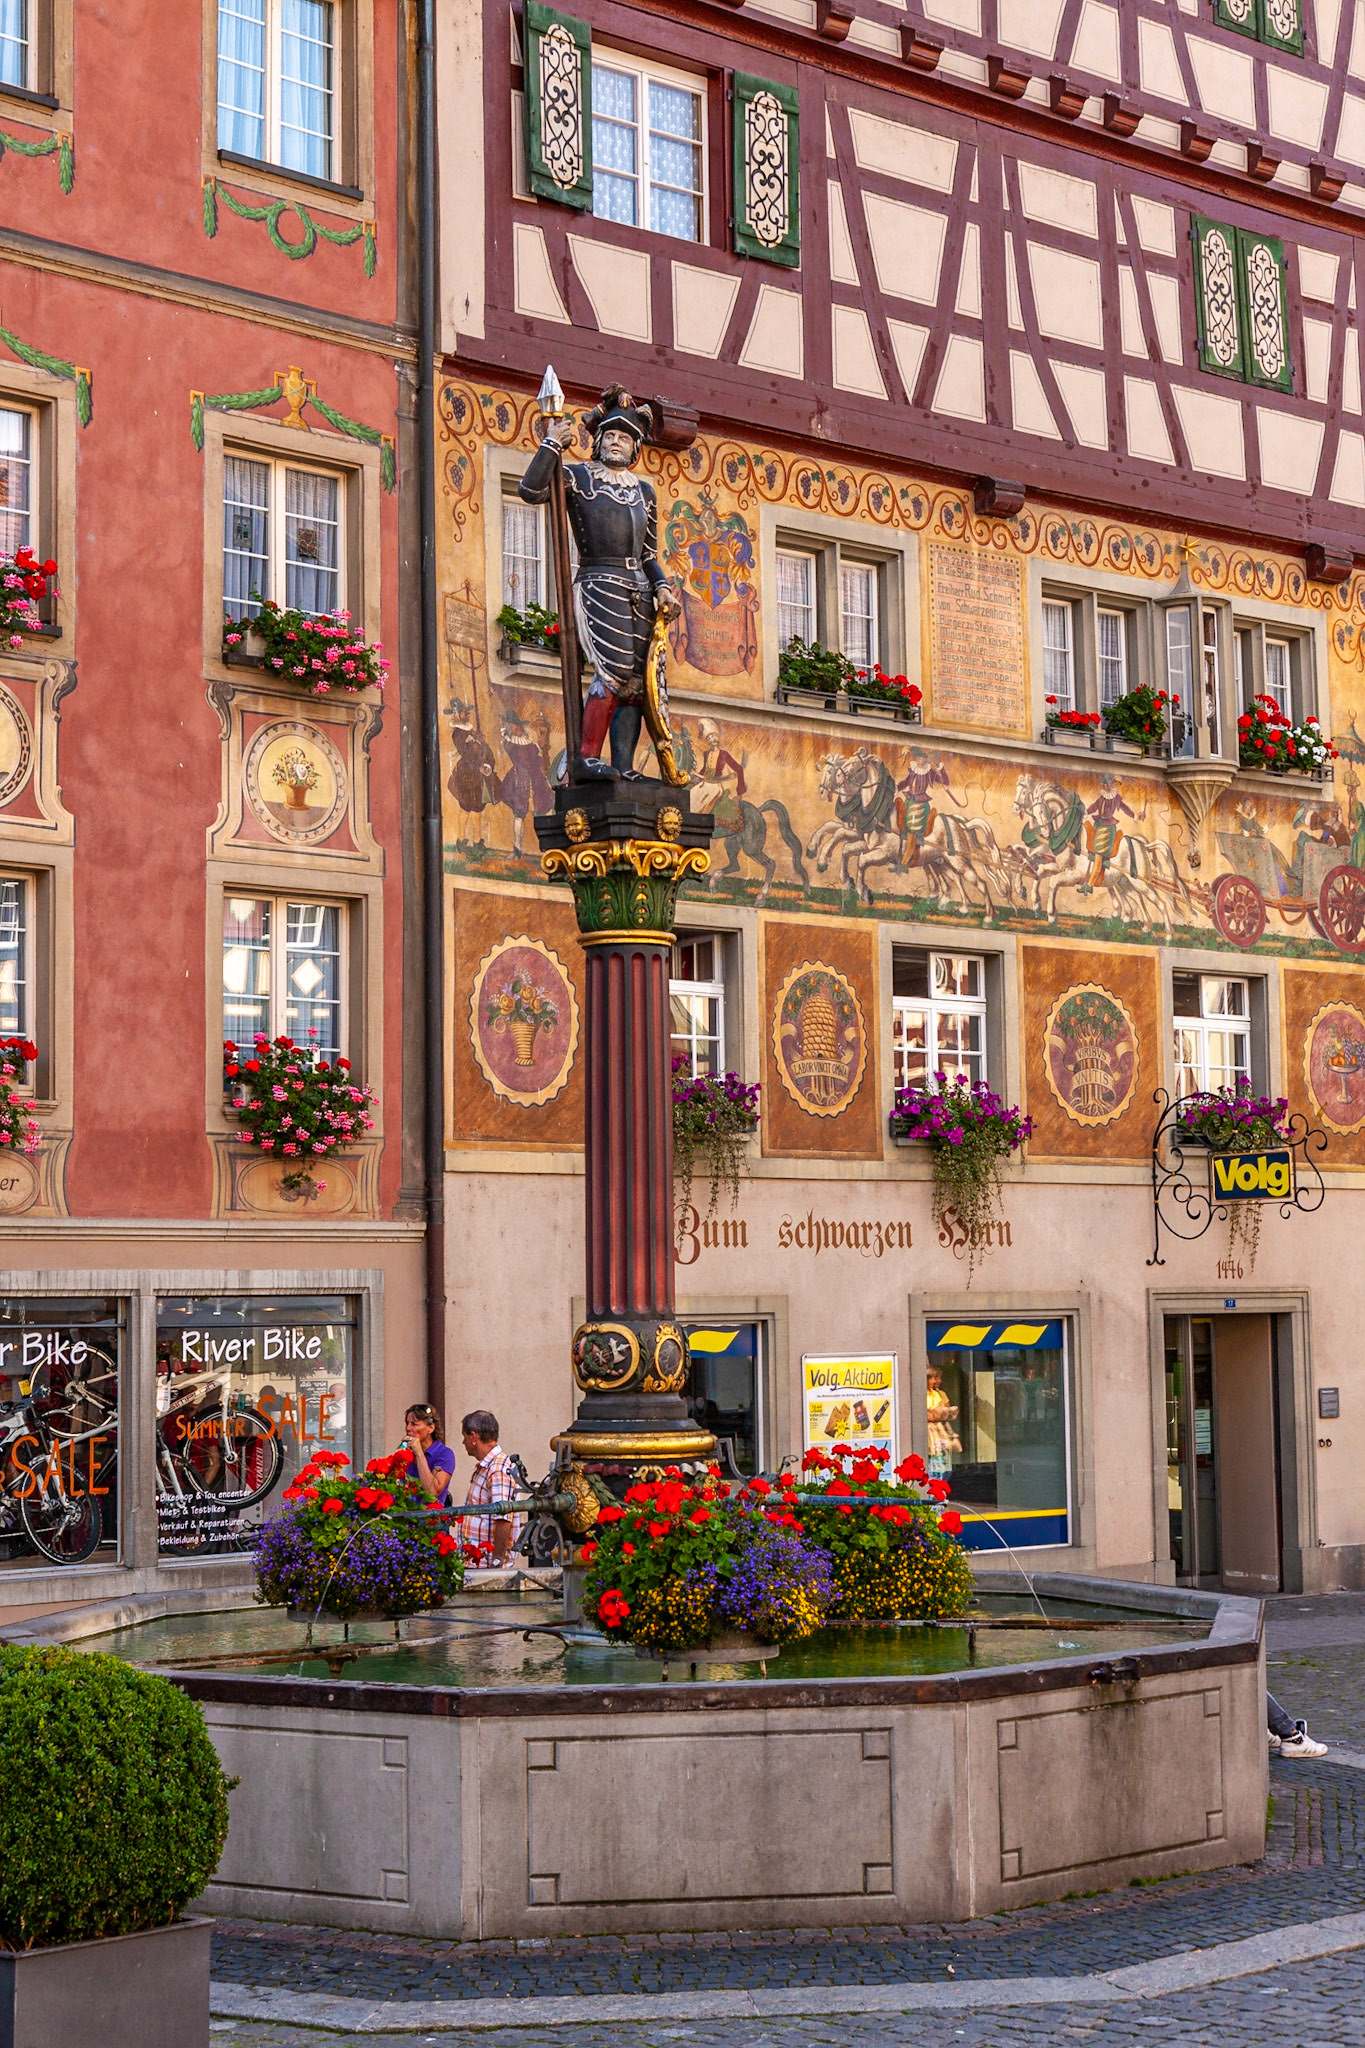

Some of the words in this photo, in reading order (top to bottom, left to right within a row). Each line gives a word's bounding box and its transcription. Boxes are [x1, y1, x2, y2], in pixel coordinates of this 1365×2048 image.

[1077, 1047, 1107, 1060] VIRIBVS
[793, 1062, 814, 1076] LABOR
[1075, 1069, 1109, 1086] VNITIS
[1214, 1155, 1289, 1197] Volg
[674, 1203, 749, 1266] Zum
[778, 1208, 914, 1259] schwarzen
[22, 1331, 88, 1366] Bike
[181, 1330, 256, 1362] River
[263, 1328, 322, 1360] Bike
[256, 1393, 336, 1441] SALE
[11, 1435, 110, 1498] SALE
[195, 1492, 202, 1500] &
[203, 1490, 252, 1499] Touencenter
[182, 1507, 189, 1515] &
[191, 1505, 226, 1515] Testbikes
[160, 1521, 188, 1531] Verkauf
[190, 1520, 197, 1529] &
[199, 1519, 245, 1531] Reparaturen
[160, 1536, 199, 1546] Bekleidung
